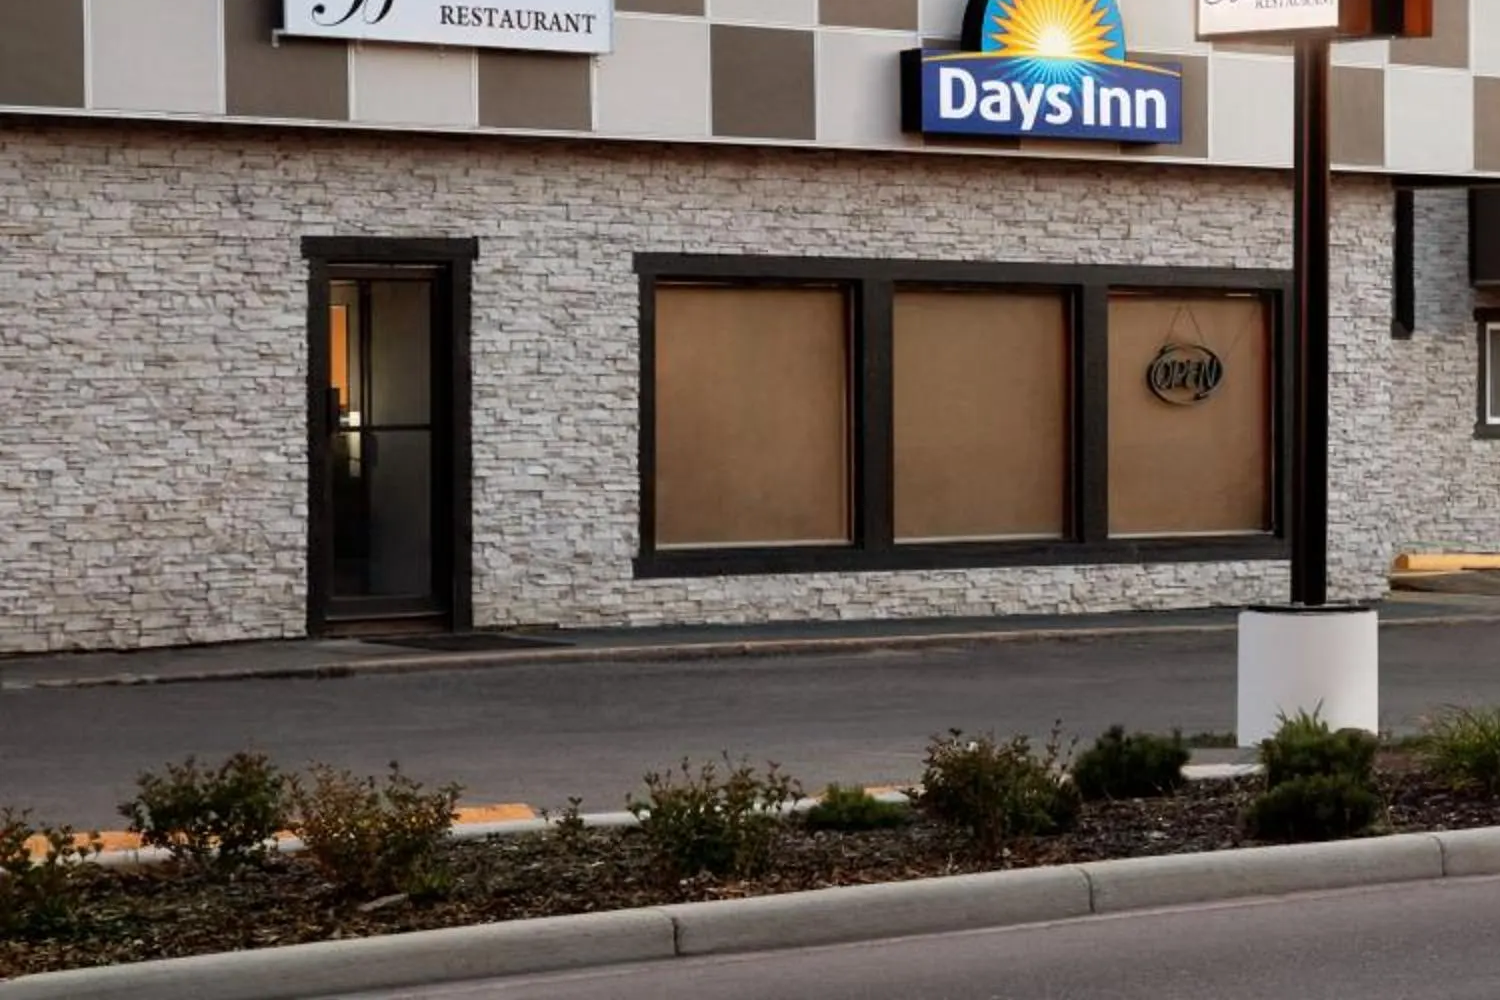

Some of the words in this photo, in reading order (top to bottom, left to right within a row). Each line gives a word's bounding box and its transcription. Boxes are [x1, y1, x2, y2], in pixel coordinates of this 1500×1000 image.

[439, 4, 597, 35] RESTAURANT
[938, 66, 1073, 131] Days
[1082, 75, 1167, 129] Inn
[1151, 357, 1220, 393] OPEN
